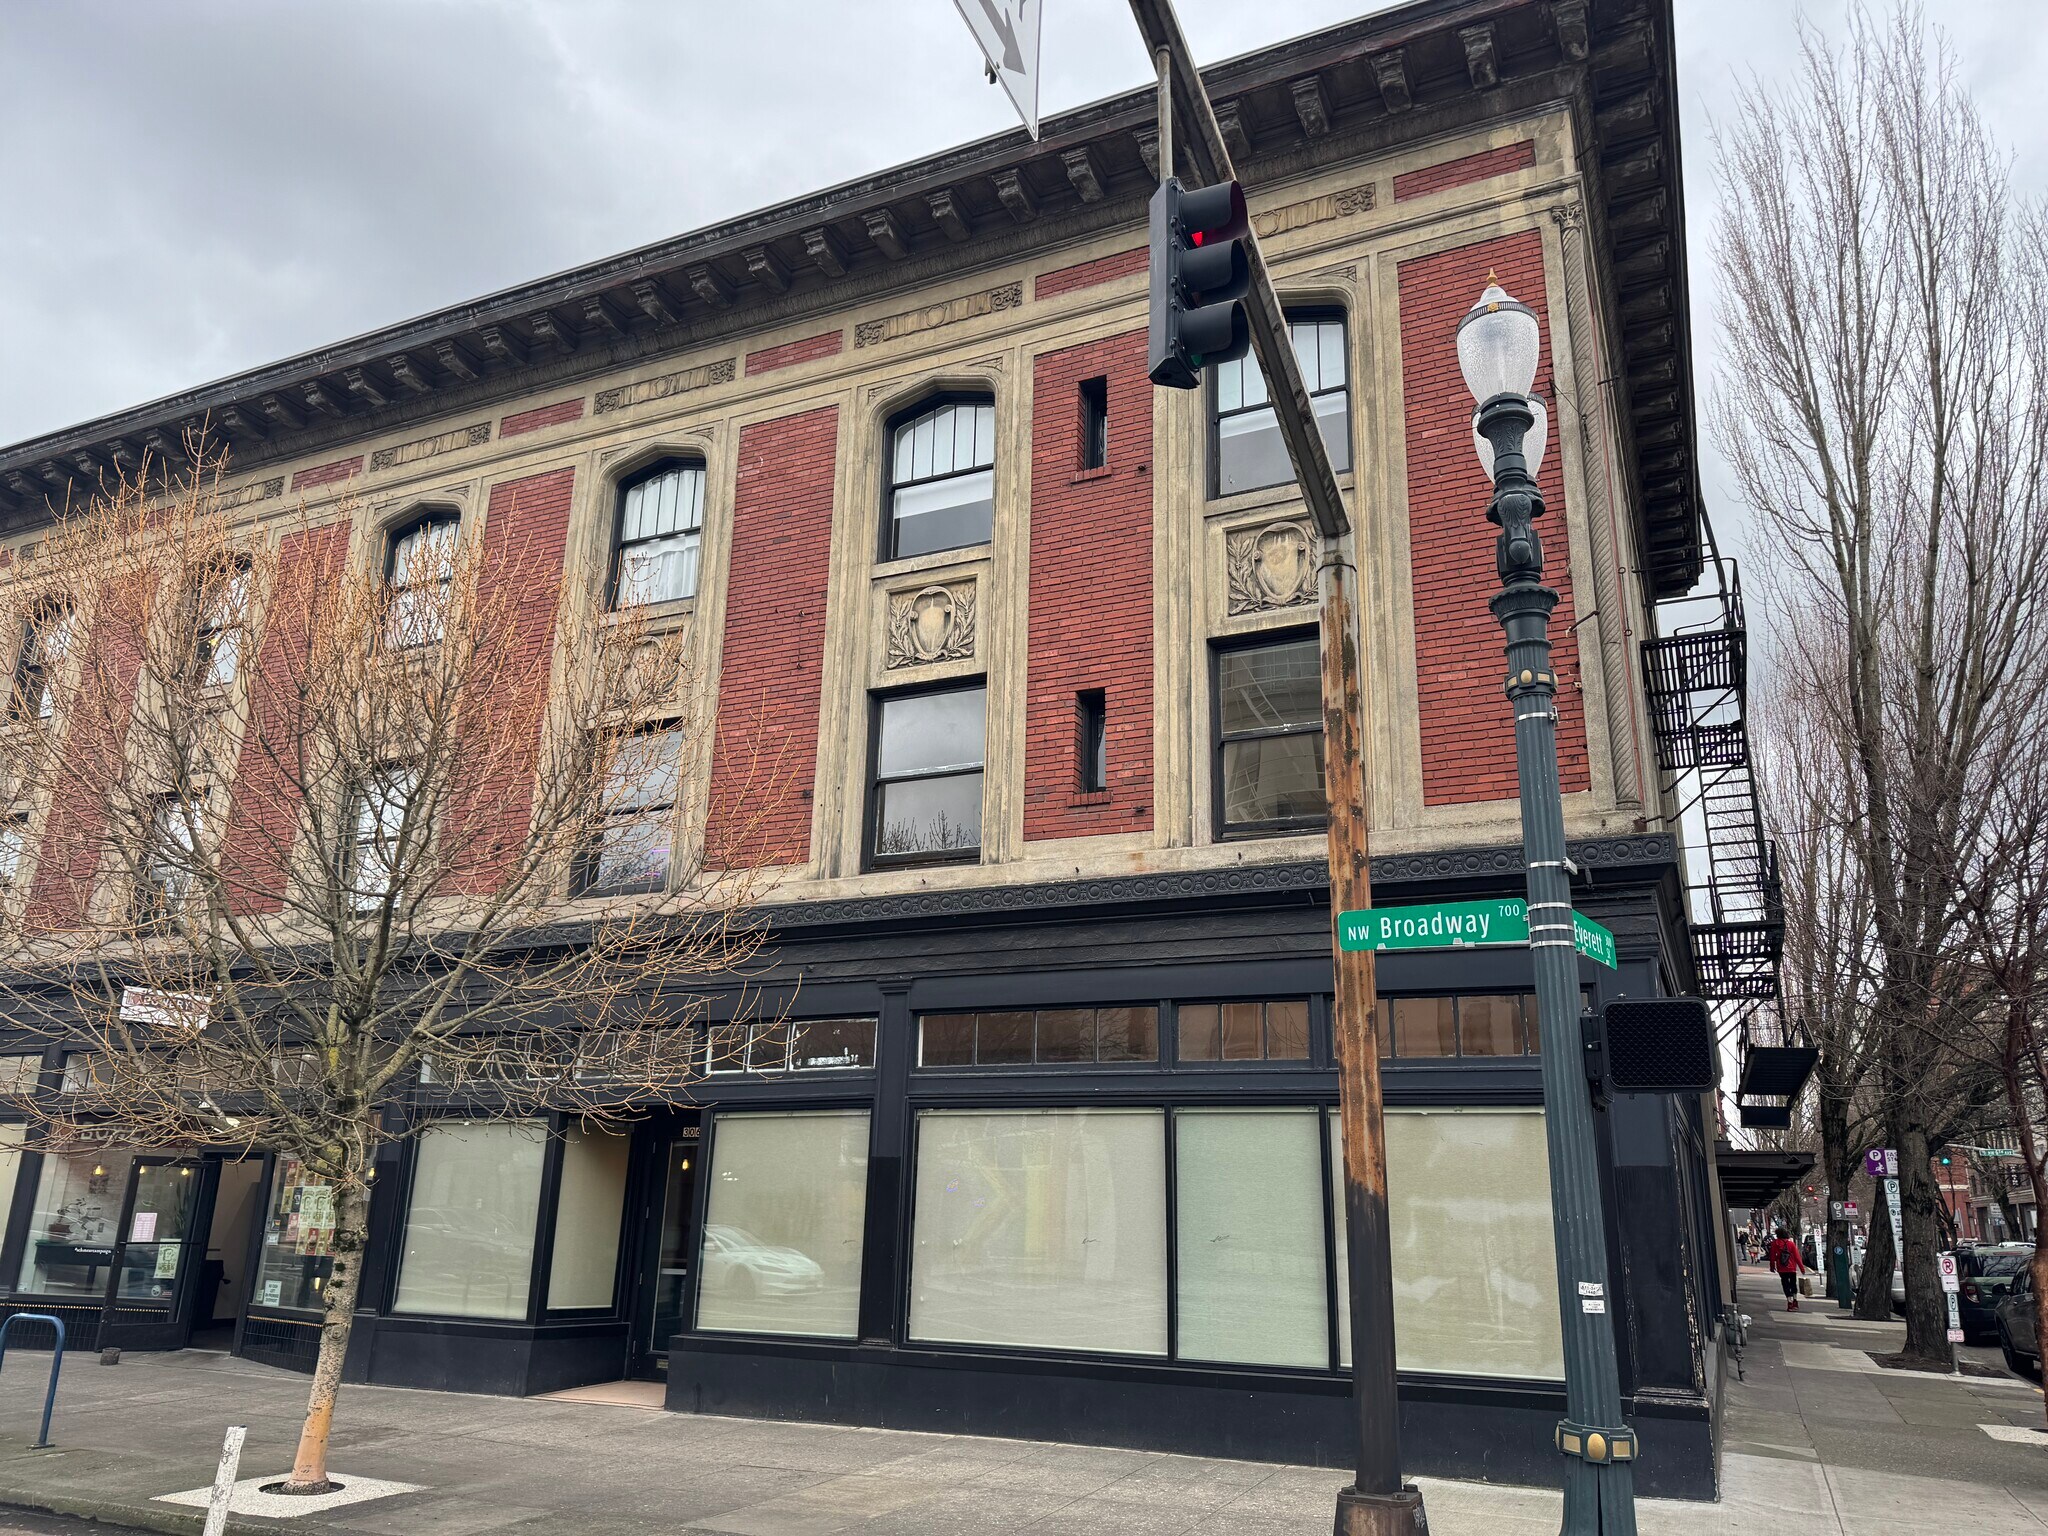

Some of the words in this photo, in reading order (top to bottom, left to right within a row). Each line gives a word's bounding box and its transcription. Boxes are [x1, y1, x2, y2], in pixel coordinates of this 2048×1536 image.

[1348, 926, 1370, 941] NW
[1380, 911, 1490, 939] Broadway
[1498, 904, 1520, 918] 700
[1573, 920, 1604, 956] Everett
[1872, 1151, 1879, 1160] P
[1835, 1210, 1842, 1218] 5
